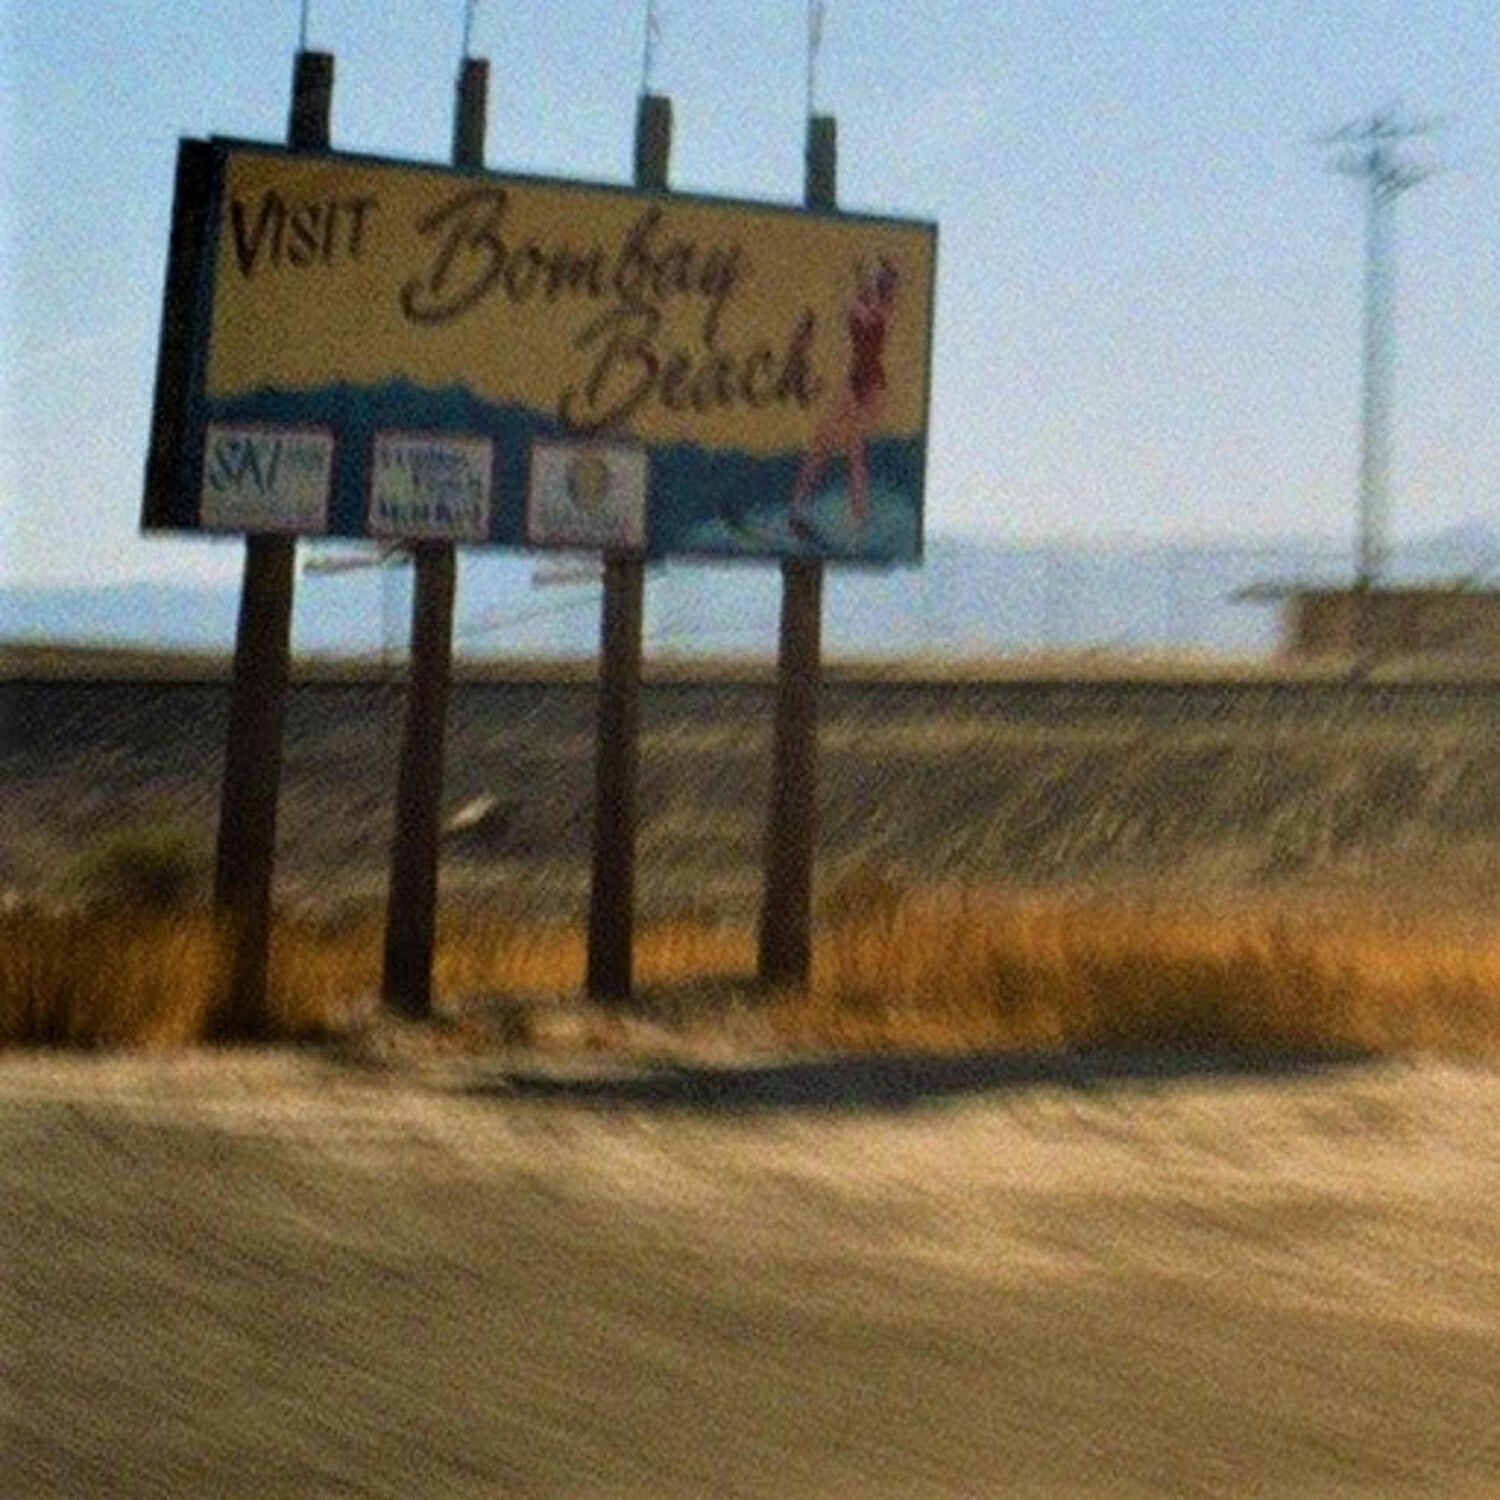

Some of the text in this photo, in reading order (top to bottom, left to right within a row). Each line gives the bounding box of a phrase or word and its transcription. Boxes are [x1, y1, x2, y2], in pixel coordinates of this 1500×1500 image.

[231, 188, 742, 349] VISIT Bombay
[559, 303, 820, 437] Beach
